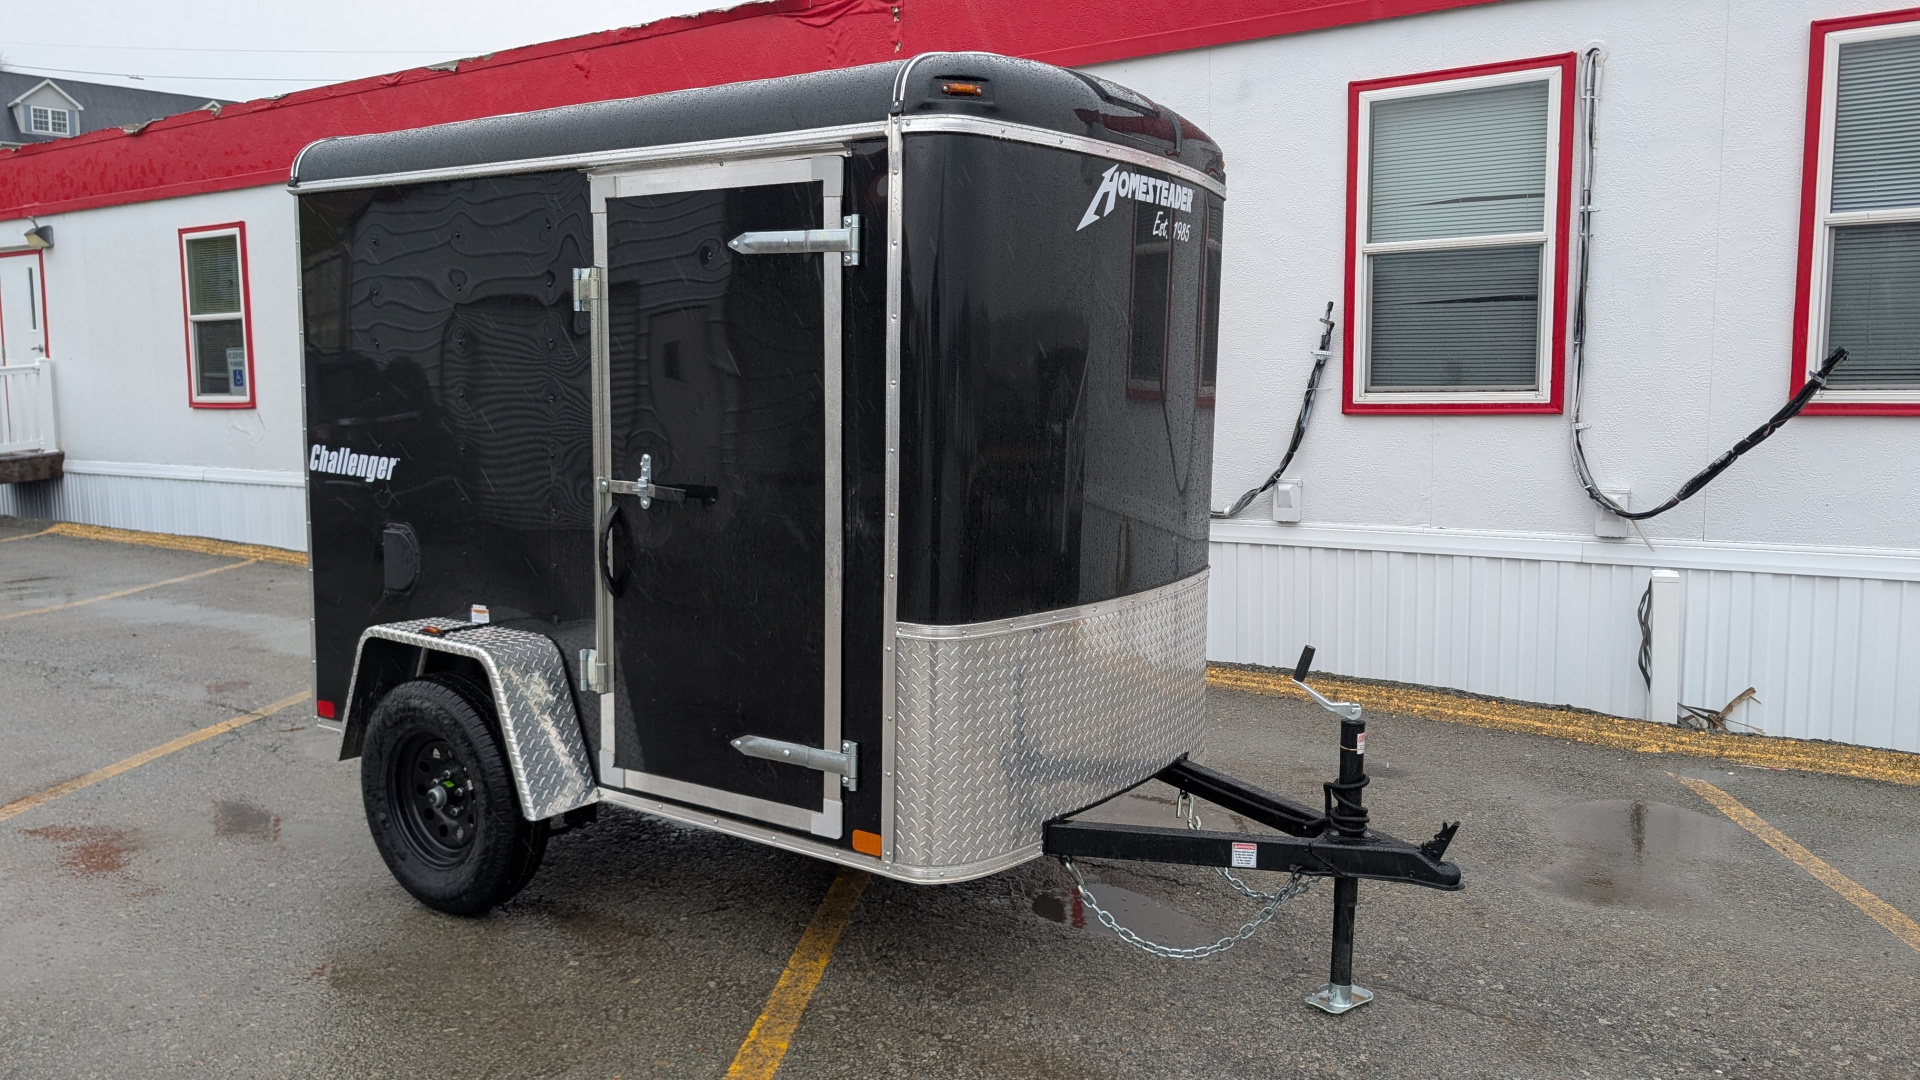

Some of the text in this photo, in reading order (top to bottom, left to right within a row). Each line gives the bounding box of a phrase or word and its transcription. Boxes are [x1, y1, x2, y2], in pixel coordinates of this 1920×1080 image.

[1076, 163, 1194, 232] HOMESTEADER
[1173, 221, 1191, 242] 1985
[309, 443, 398, 483] Challenger
